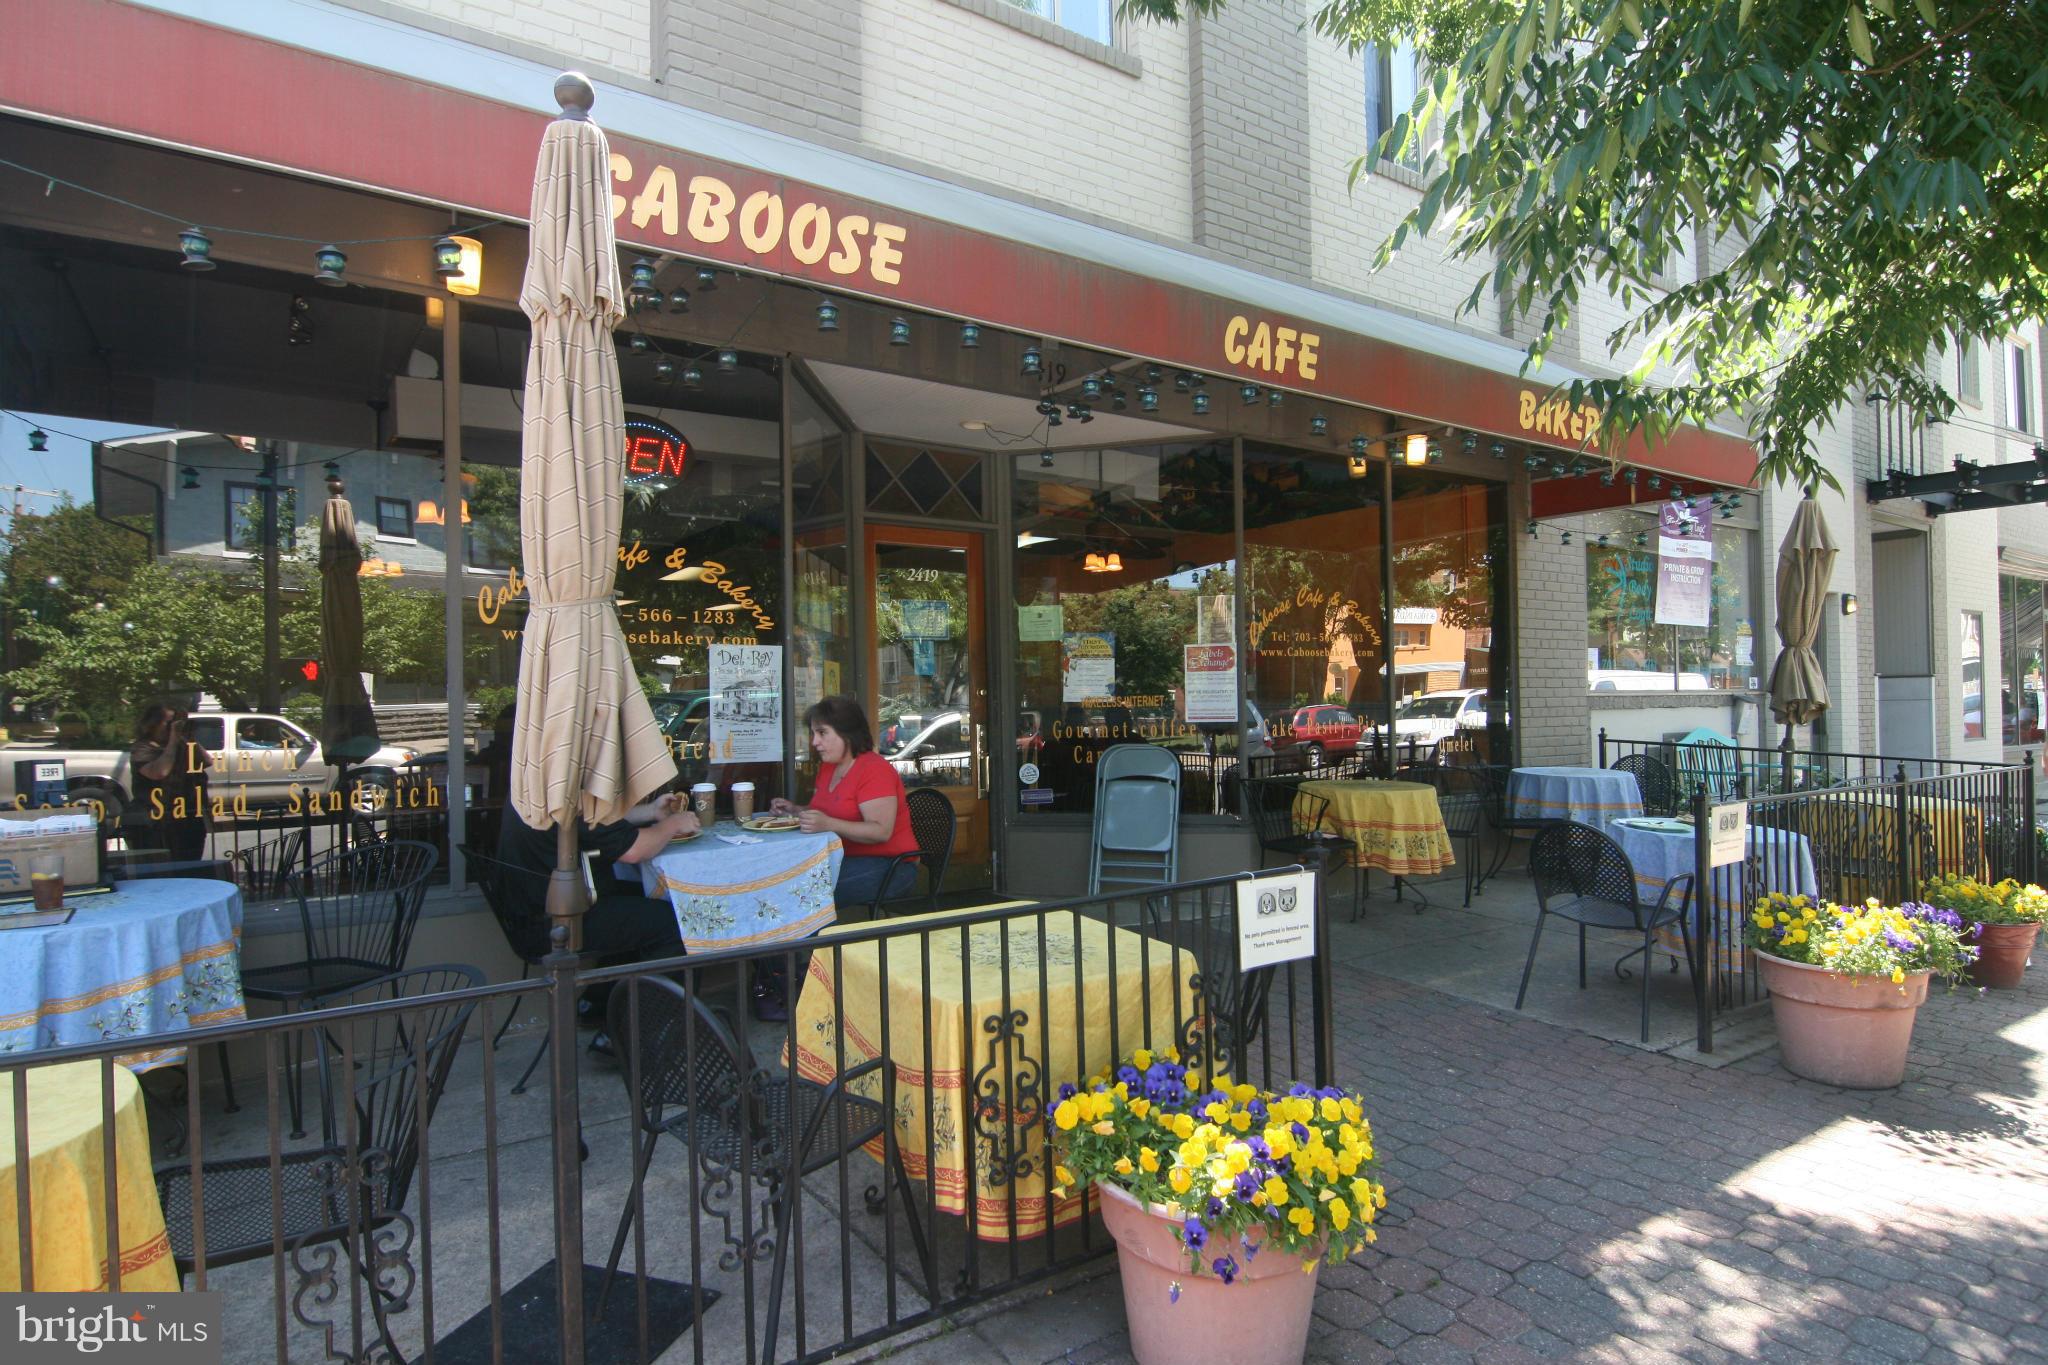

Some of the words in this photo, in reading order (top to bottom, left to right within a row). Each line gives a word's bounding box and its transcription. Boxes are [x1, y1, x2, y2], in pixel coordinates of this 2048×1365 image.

[608, 152, 907, 286] CABOOSE
[1224, 315, 1321, 381] CAFE
[1519, 389, 1601, 448] BAKER
[617, 541, 650, 571] afe
[665, 547, 687, 570] &
[699, 560, 775, 630] Bakery
[906, 567, 939, 583] 2419
[1249, 599, 1292, 649] Caboose
[1296, 585, 1324, 608] Cafe
[1330, 591, 1342, 606] &
[1346, 599, 1383, 646] Bakery
[1081, 695, 1123, 708] WIRELESS
[1124, 694, 1165, 708] INTERNET
[1052, 720, 1129, 741] Gourmet
[1139, 719, 1198, 738] coffee
[1358, 714, 1375, 733] Pie
[1438, 735, 1474, 752] Omelet
[186, 738, 298, 775] Lunch
[150, 784, 262, 822] Salad,
[287, 777, 440, 816] Sandwich
